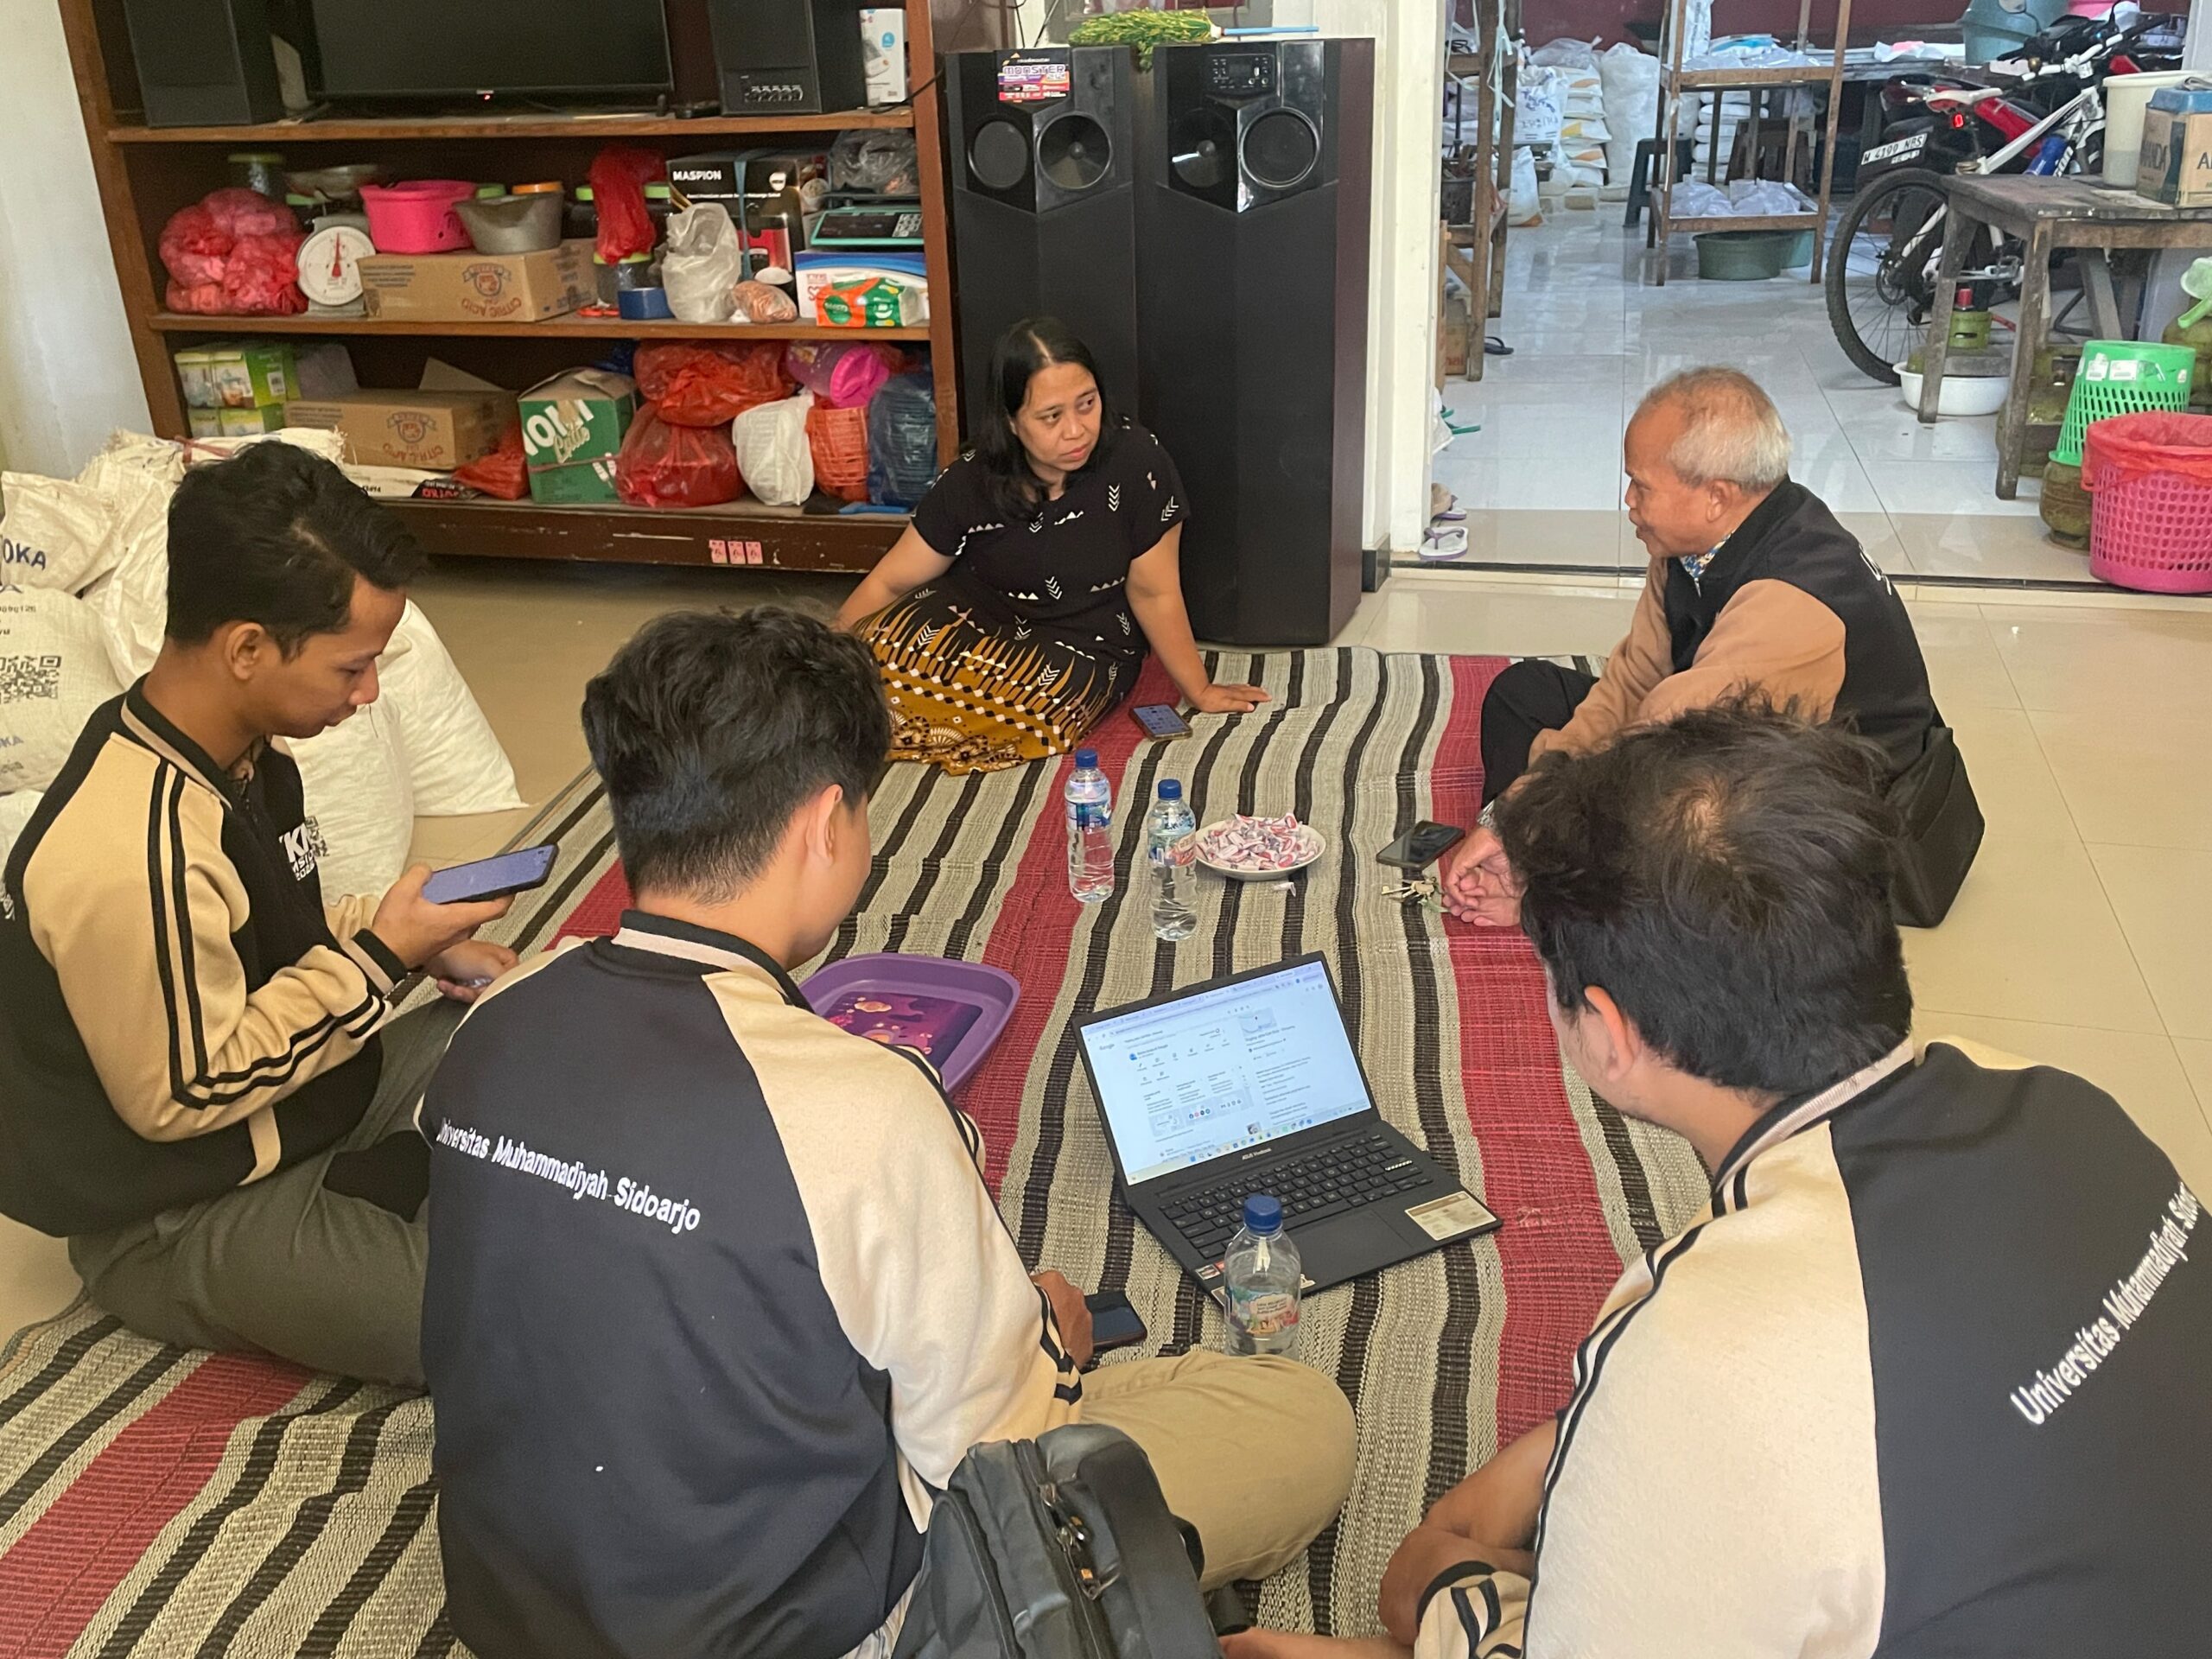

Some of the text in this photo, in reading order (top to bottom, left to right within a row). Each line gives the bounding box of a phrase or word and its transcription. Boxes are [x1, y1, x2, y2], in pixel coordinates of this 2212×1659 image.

[672, 170, 722, 181] MASPION
[461, 297, 487, 318] ACID
[491, 1135, 609, 1200] Muhammadiyah
[613, 1176, 701, 1235] Sidoarjo
[2010, 1316, 2121, 1425] Universitas
[2102, 1214, 2189, 1331] Muhammadiyah
